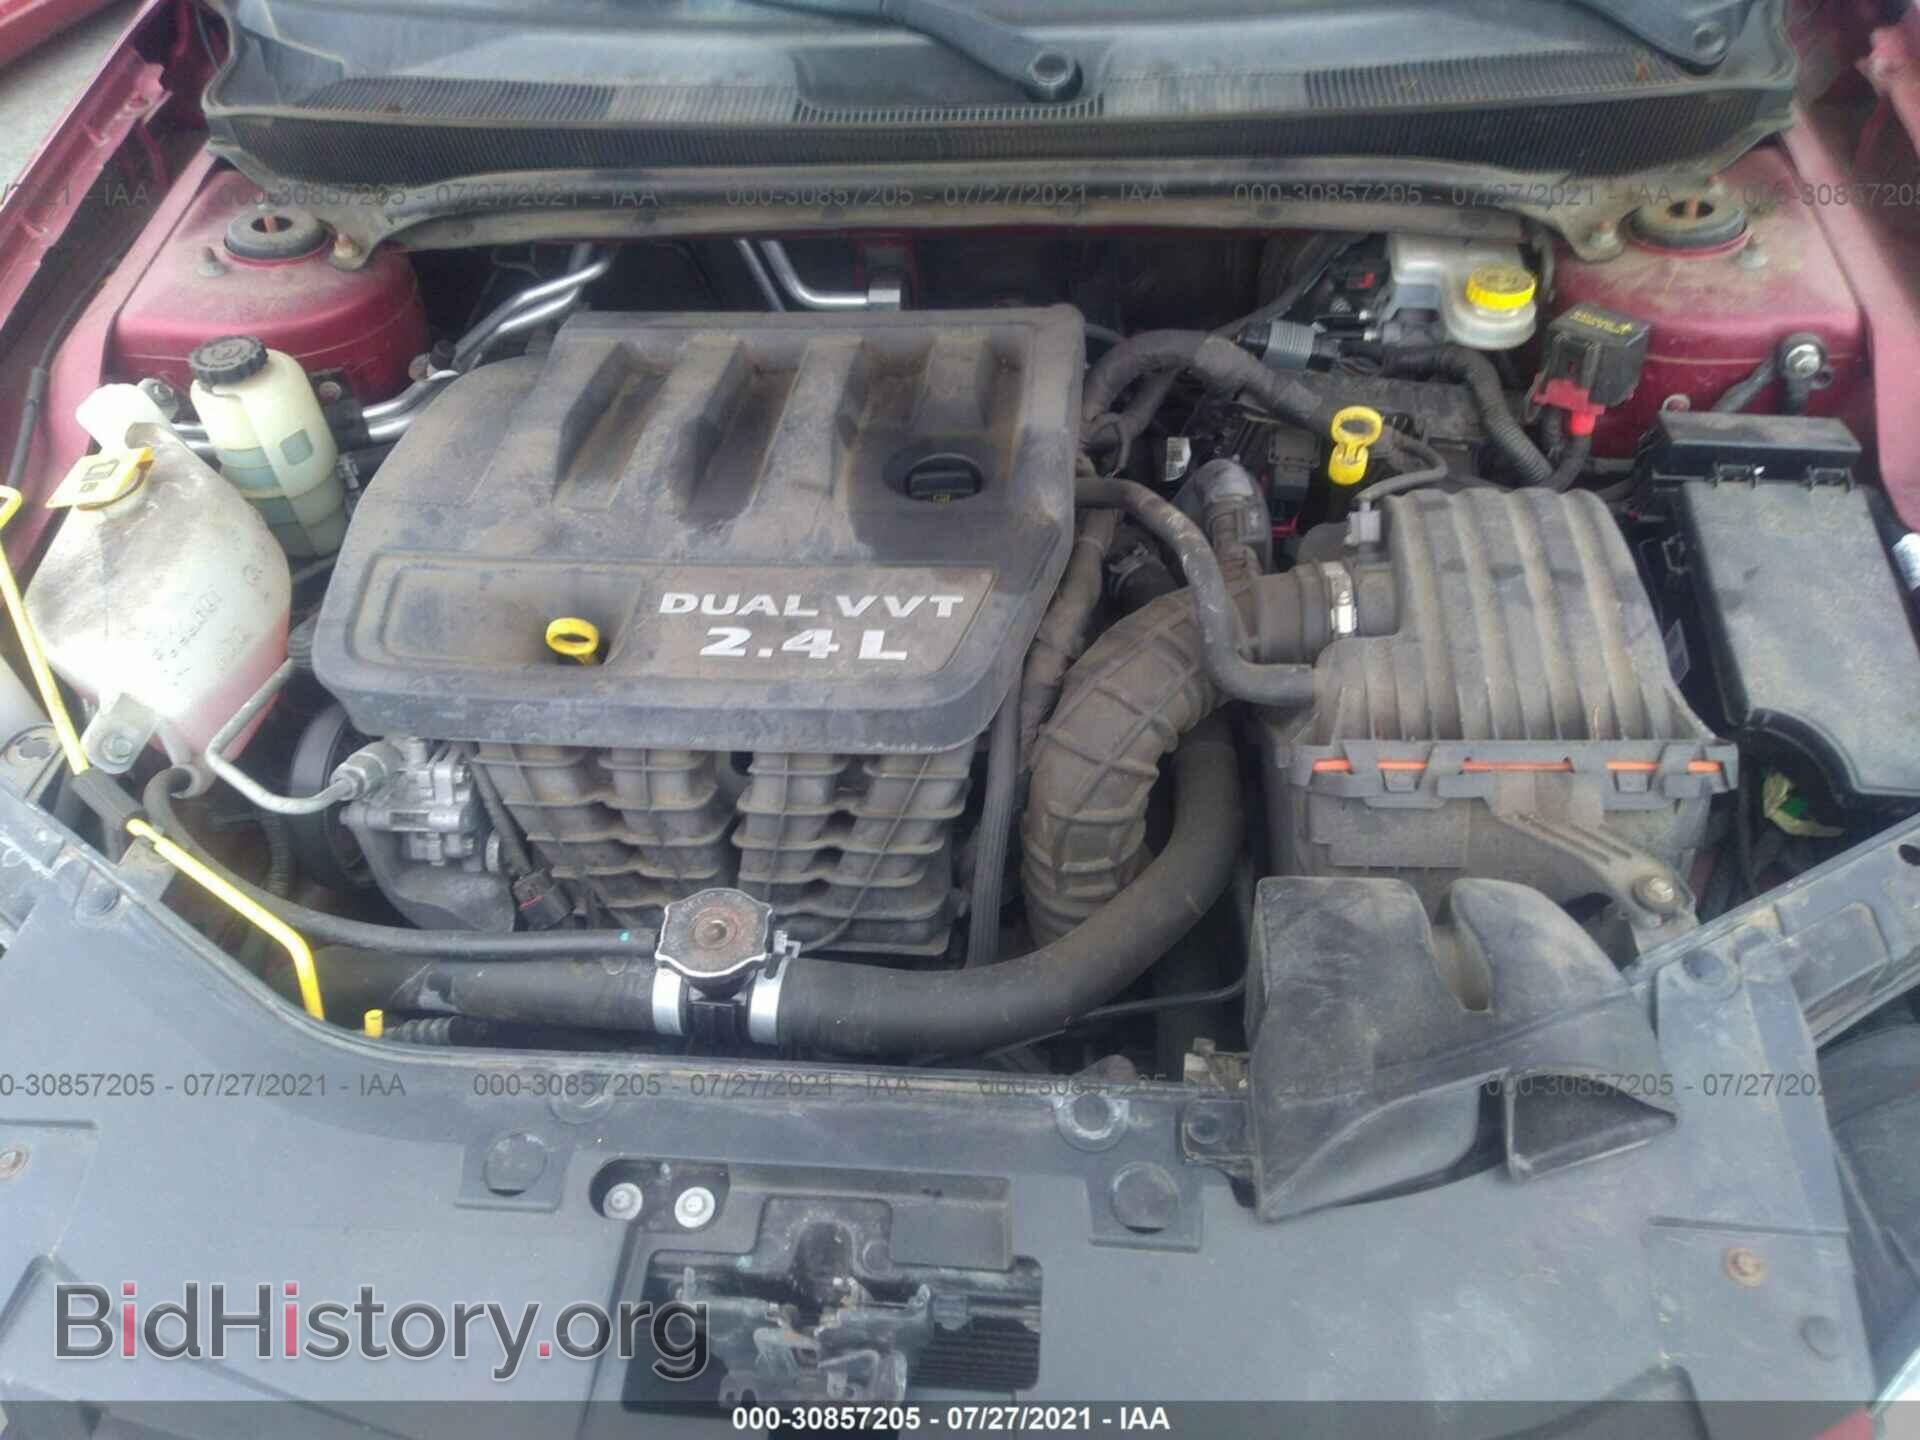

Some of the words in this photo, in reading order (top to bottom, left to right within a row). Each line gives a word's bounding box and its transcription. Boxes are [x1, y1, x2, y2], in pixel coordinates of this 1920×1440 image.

[658, 592, 820, 617] DUAL
[835, 594, 964, 618] VVT
[700, 627, 841, 659] 2.4
